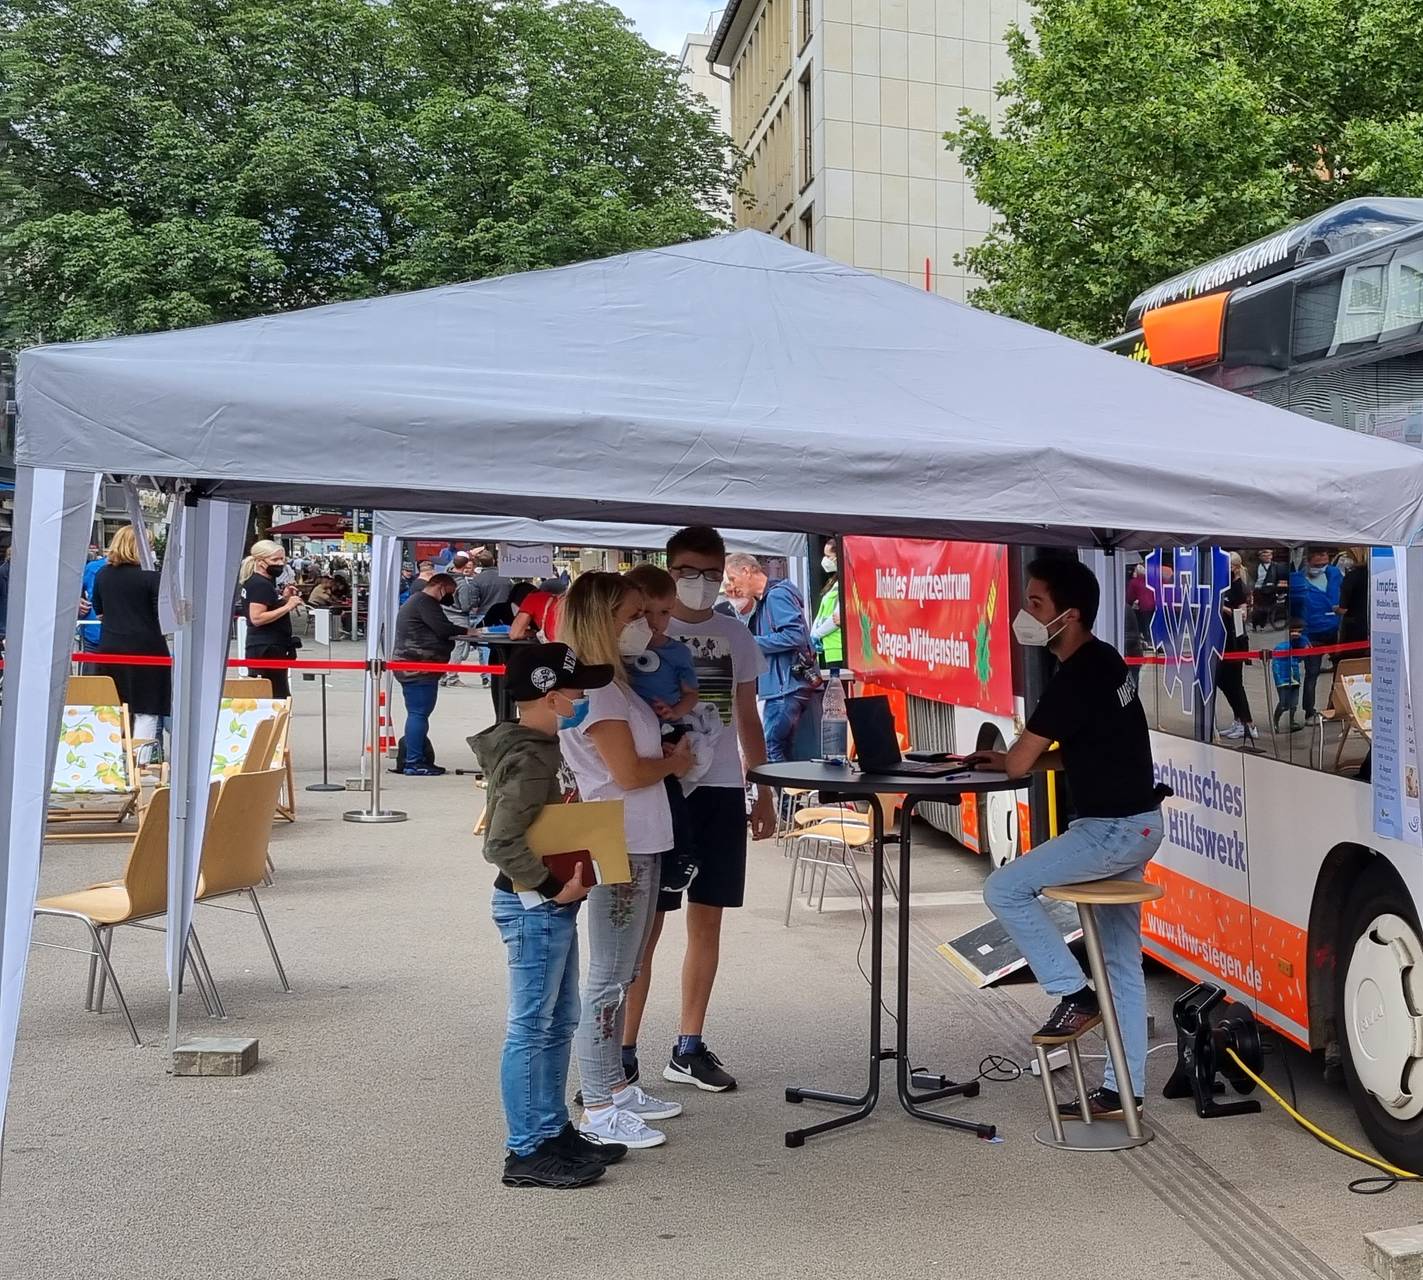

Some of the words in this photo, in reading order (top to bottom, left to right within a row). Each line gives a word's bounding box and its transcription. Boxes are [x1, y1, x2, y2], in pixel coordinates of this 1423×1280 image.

[876, 568, 907, 600] Mobiles
[908, 566, 970, 608] Impfzentrum
[877, 624, 970, 671] Siegen-Wittgenstein
[1152, 758, 1243, 818] echnisches
[1167, 806, 1246, 873] Hilfswerk
[1147, 911, 1263, 993] www.thw-siegen.de
